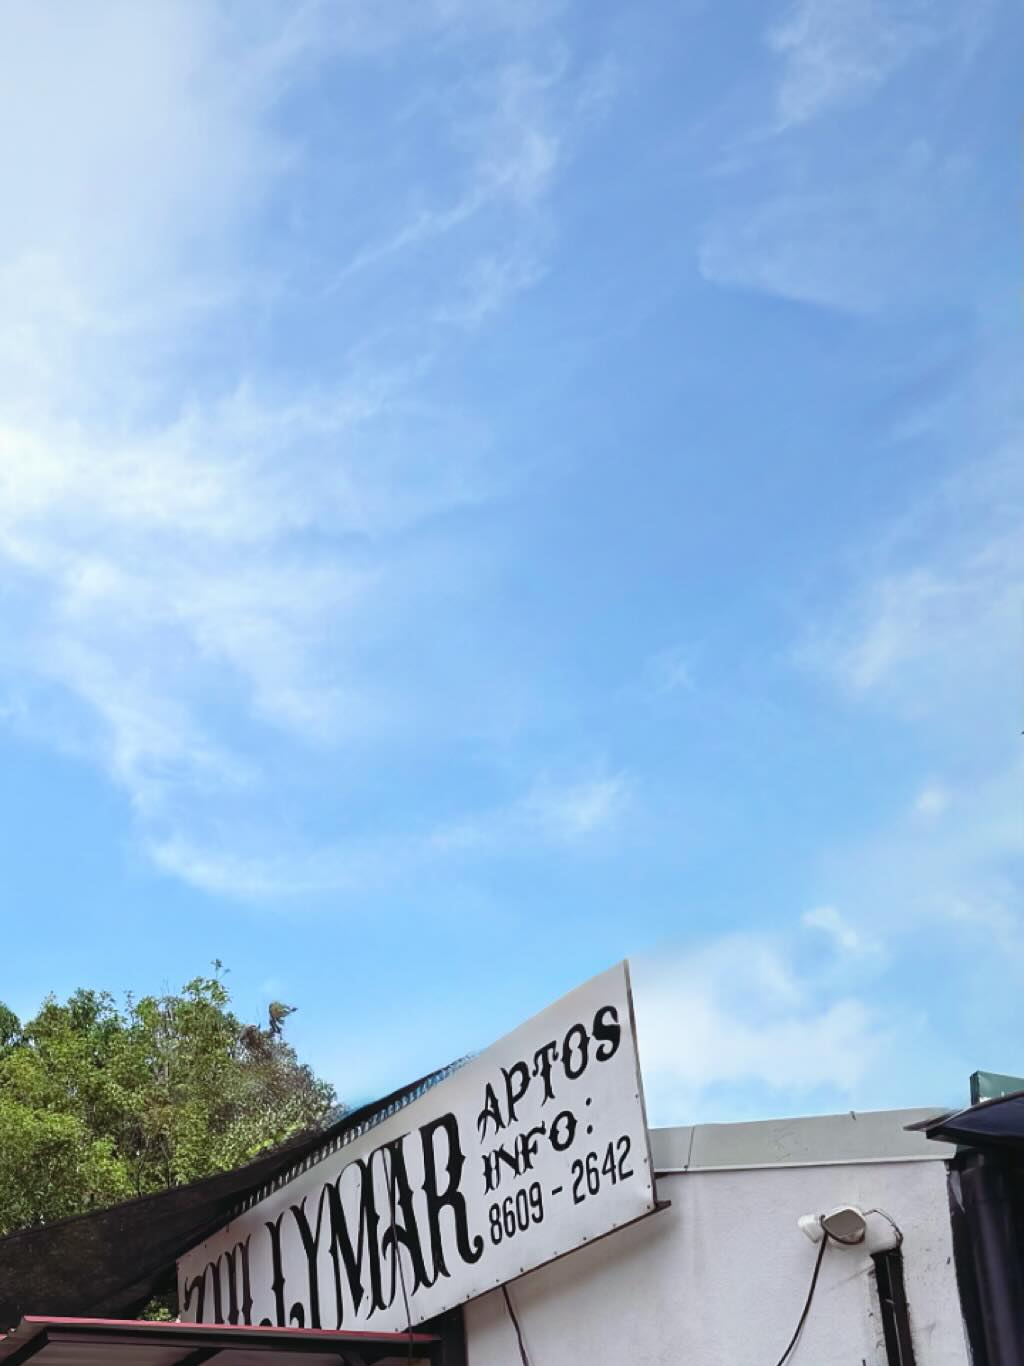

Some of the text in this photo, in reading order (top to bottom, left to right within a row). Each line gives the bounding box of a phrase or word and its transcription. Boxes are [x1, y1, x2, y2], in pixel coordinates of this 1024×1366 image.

[477, 1005, 621, 1144] APTOS
[489, 1181, 544, 1245] 8609
[571, 1135, 634, 1204] 2642
